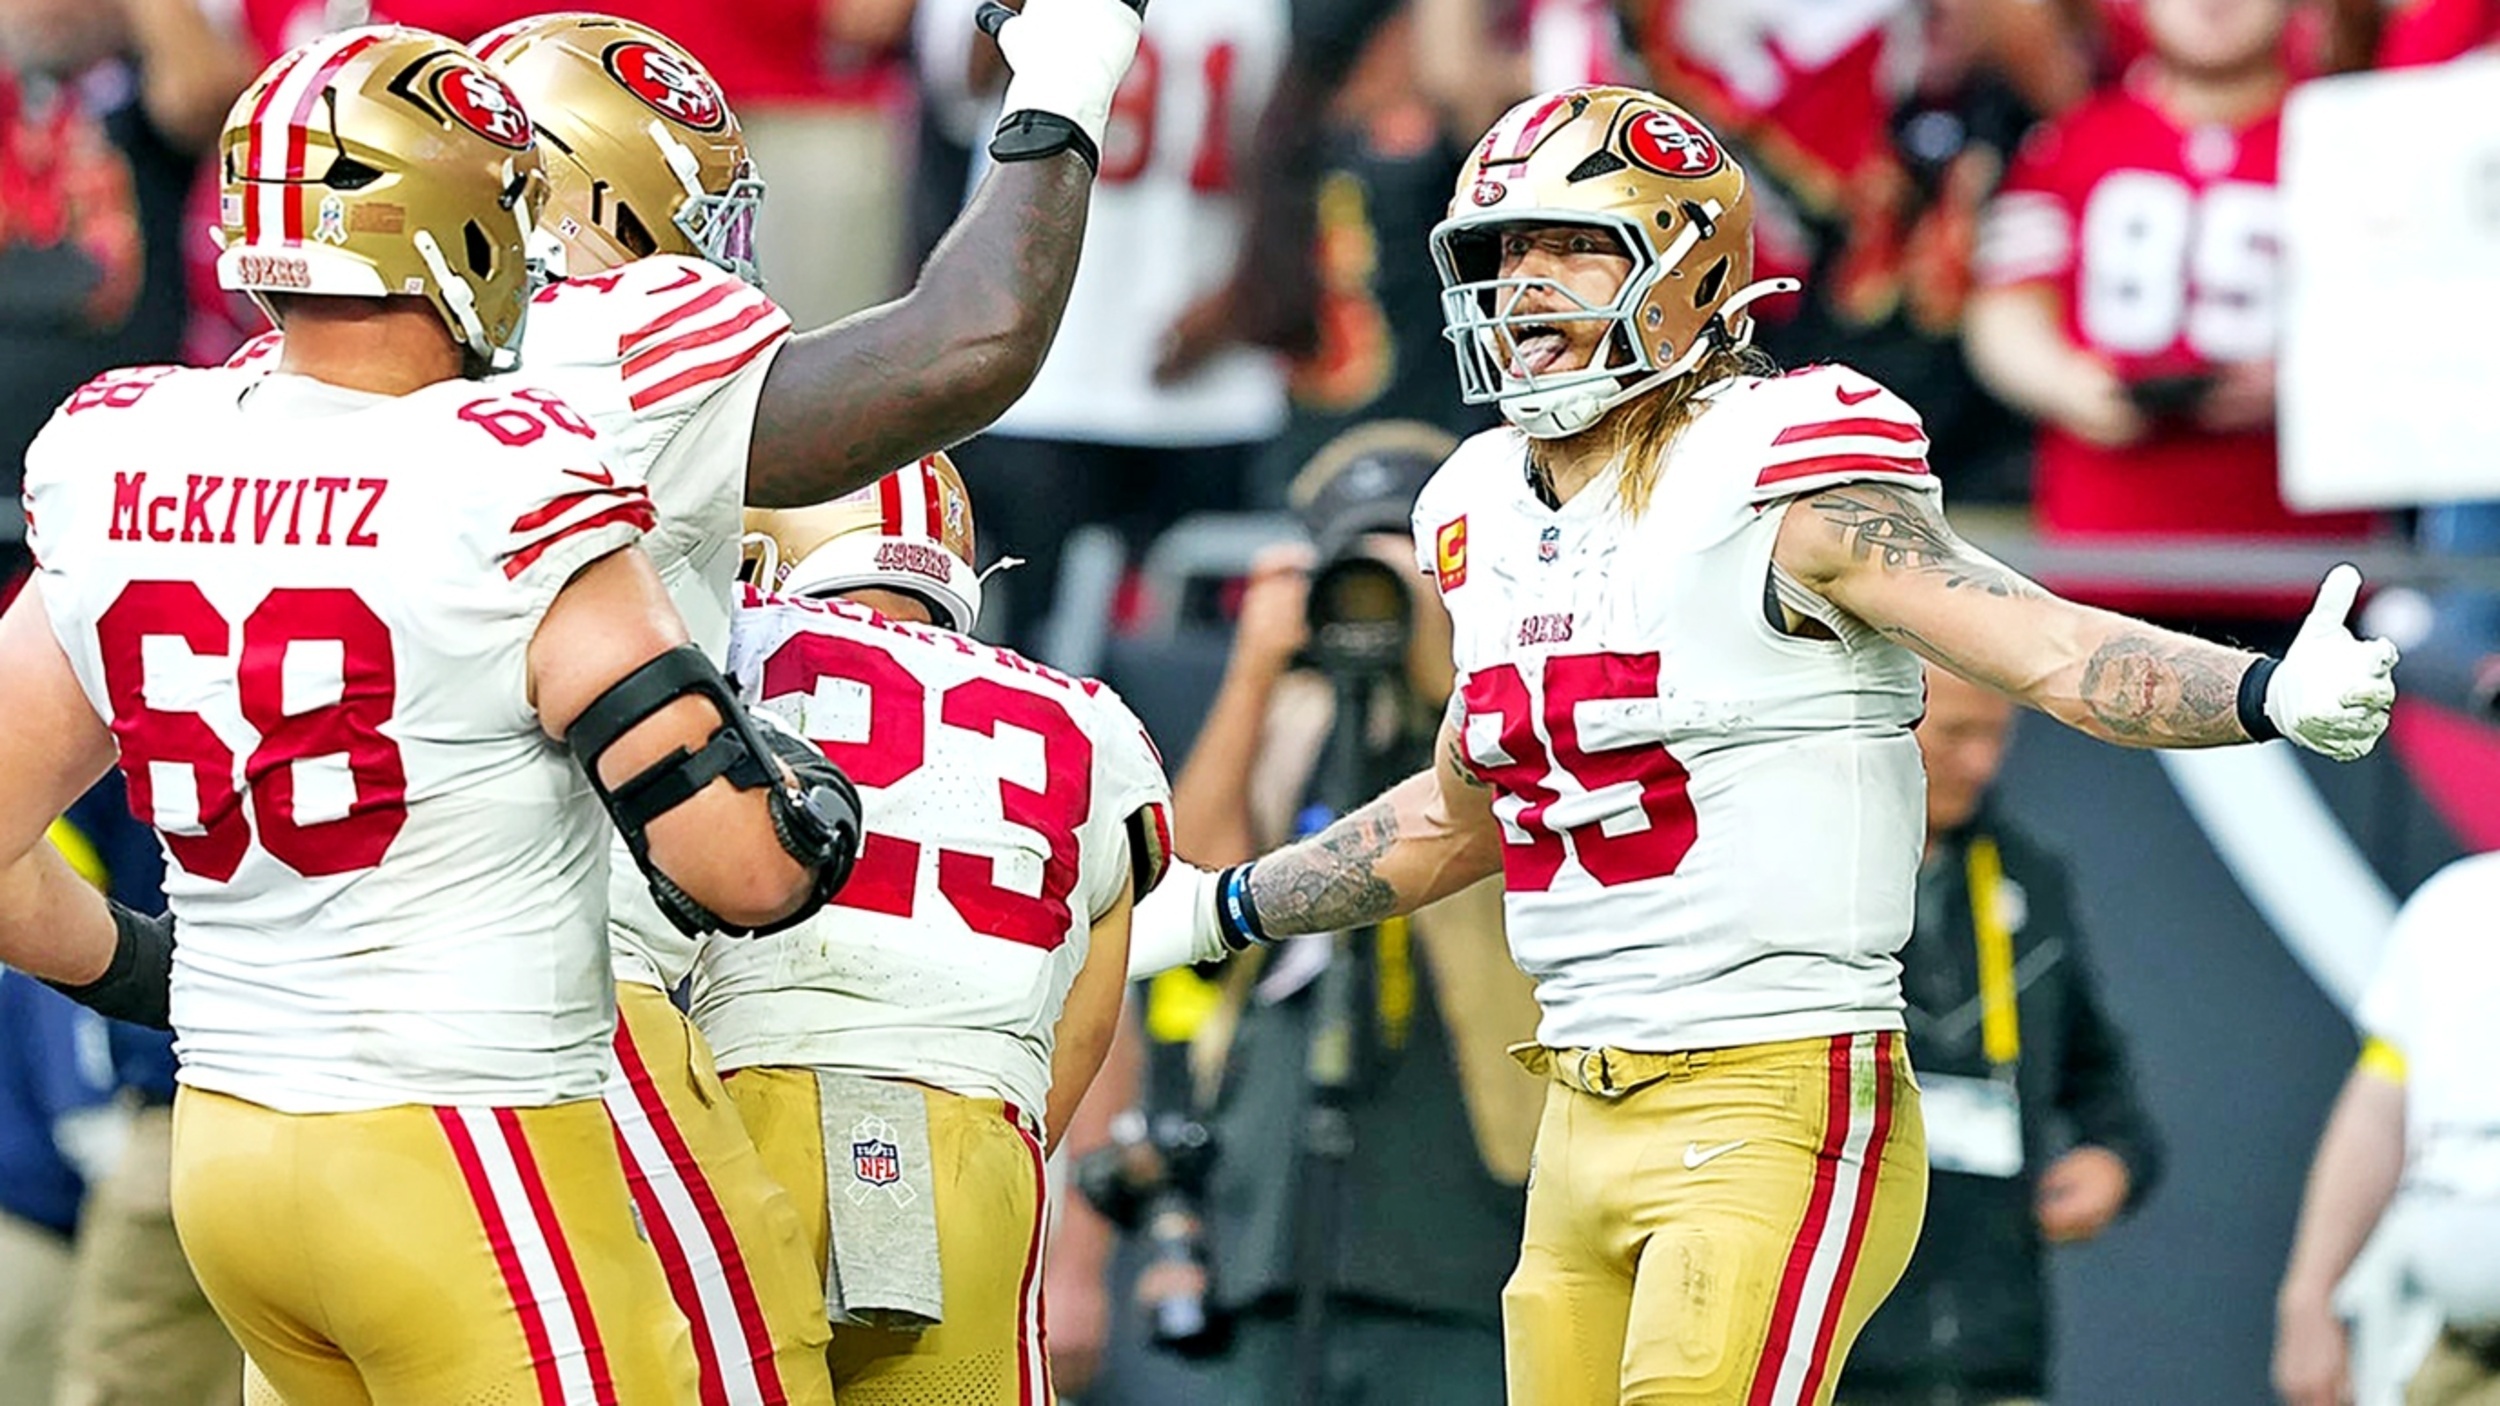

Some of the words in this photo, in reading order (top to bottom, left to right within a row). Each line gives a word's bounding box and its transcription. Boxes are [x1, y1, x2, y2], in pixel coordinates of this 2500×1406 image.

[460, 68, 526, 139] SF
[1643, 110, 1710, 169] SF
[2079, 168, 2280, 358] 85
[109, 472, 388, 547] McKIVITZ
[1438, 518, 1465, 573] C
[96, 579, 408, 883] 68
[761, 630, 1092, 952] 23
[1461, 651, 1698, 891] 85
[860, 1157, 896, 1179] NFL
